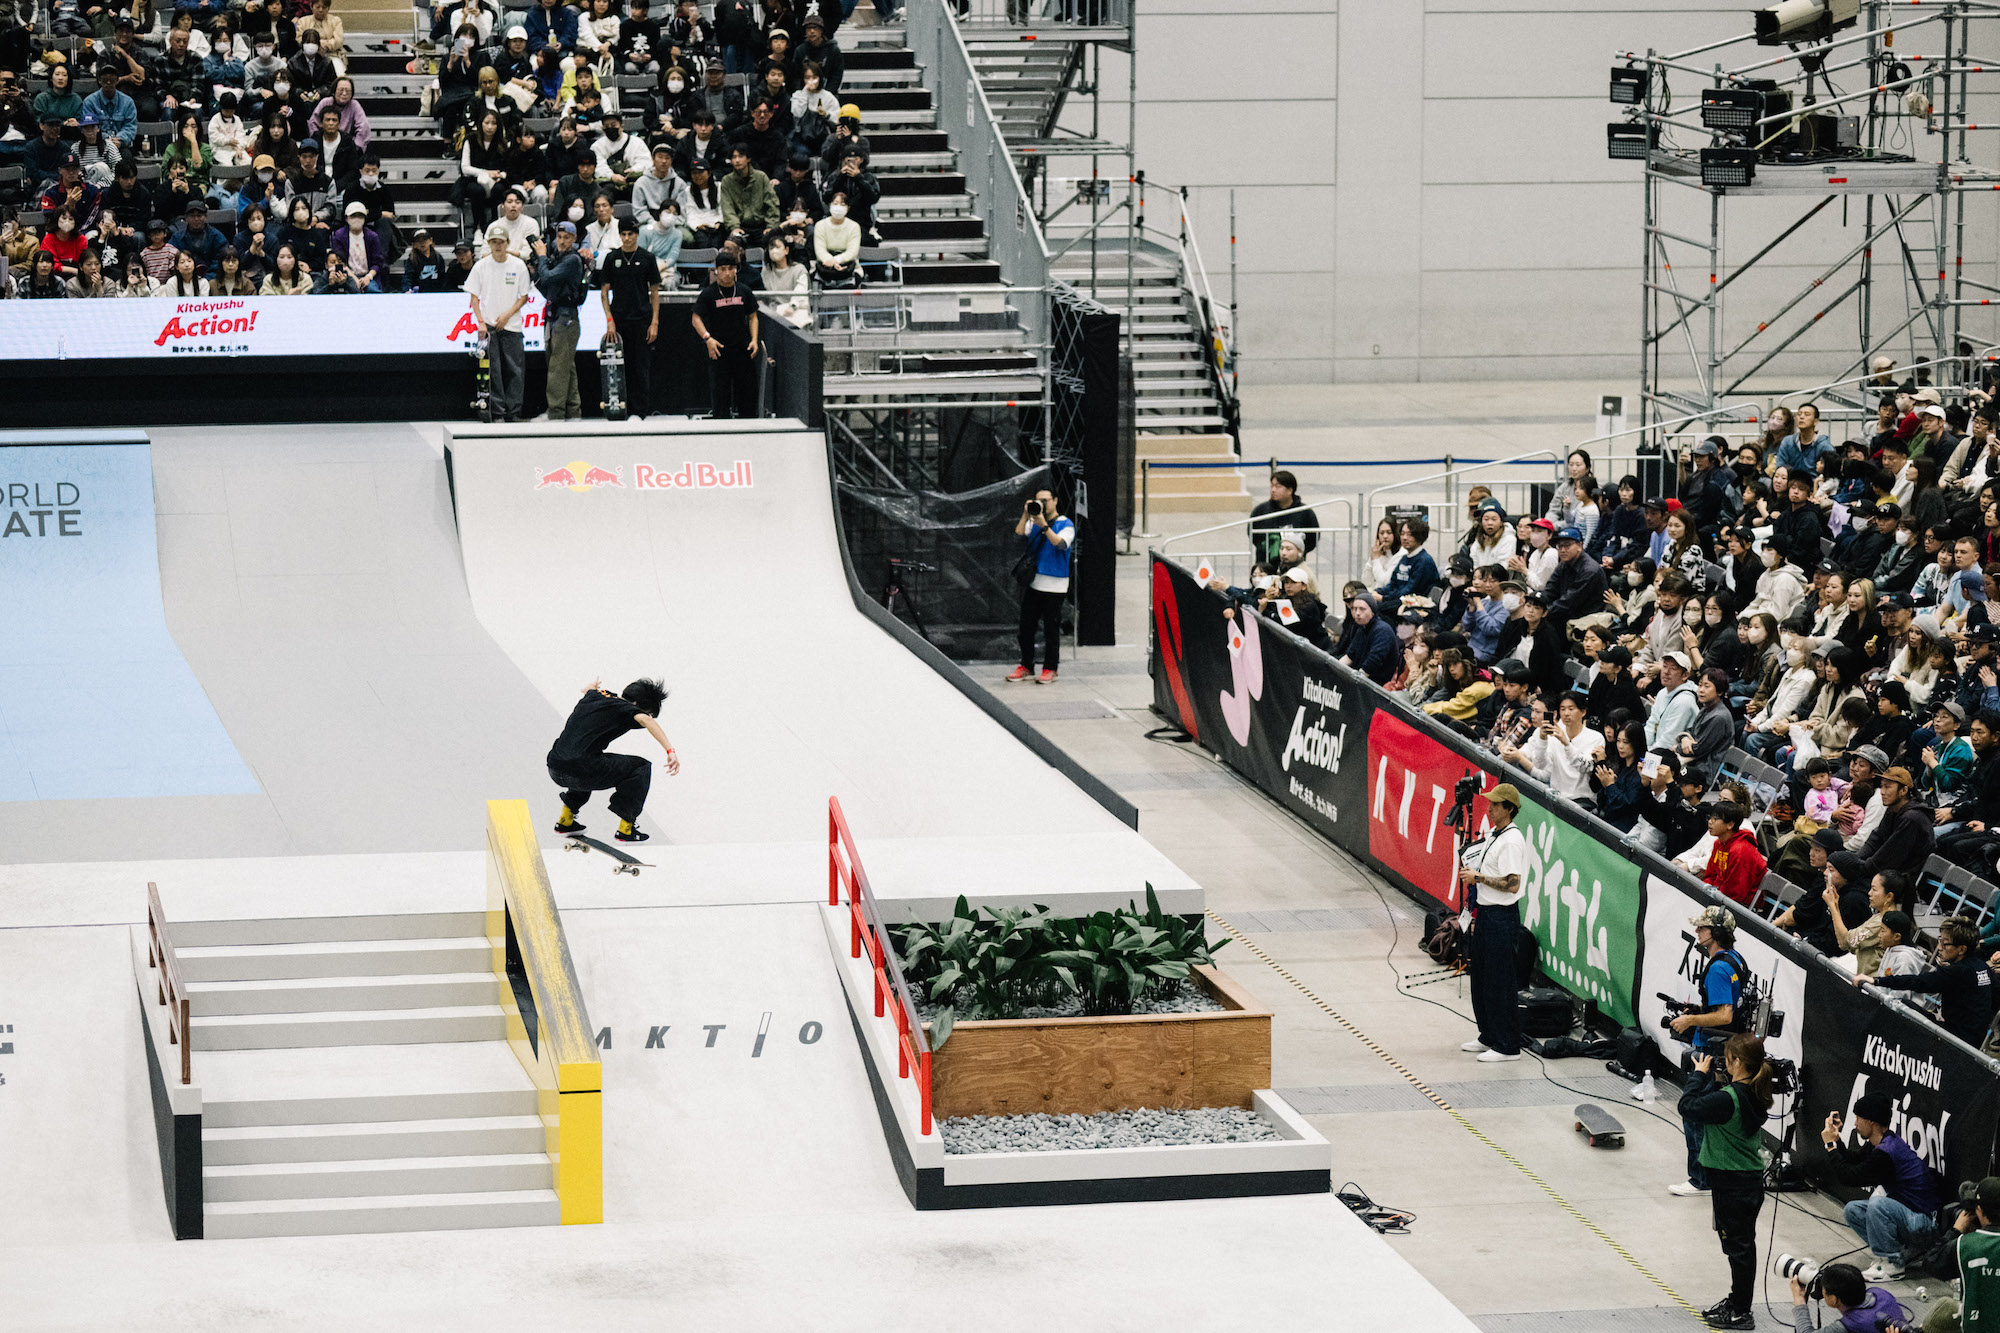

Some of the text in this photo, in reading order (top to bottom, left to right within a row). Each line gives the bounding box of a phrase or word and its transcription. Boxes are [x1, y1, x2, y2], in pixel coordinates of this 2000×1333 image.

[176, 299, 244, 313] Kitakyushu
[153, 310, 260, 347] Action!
[0, 482, 80, 507] RLD
[2, 509, 83, 538] ATE
[1302, 675, 1343, 712] Kitakyushu
[1281, 705, 1348, 775] Action!
[1862, 1033, 1943, 1092] Kitakyushu
[1838, 1072, 1952, 1177] Ation!
